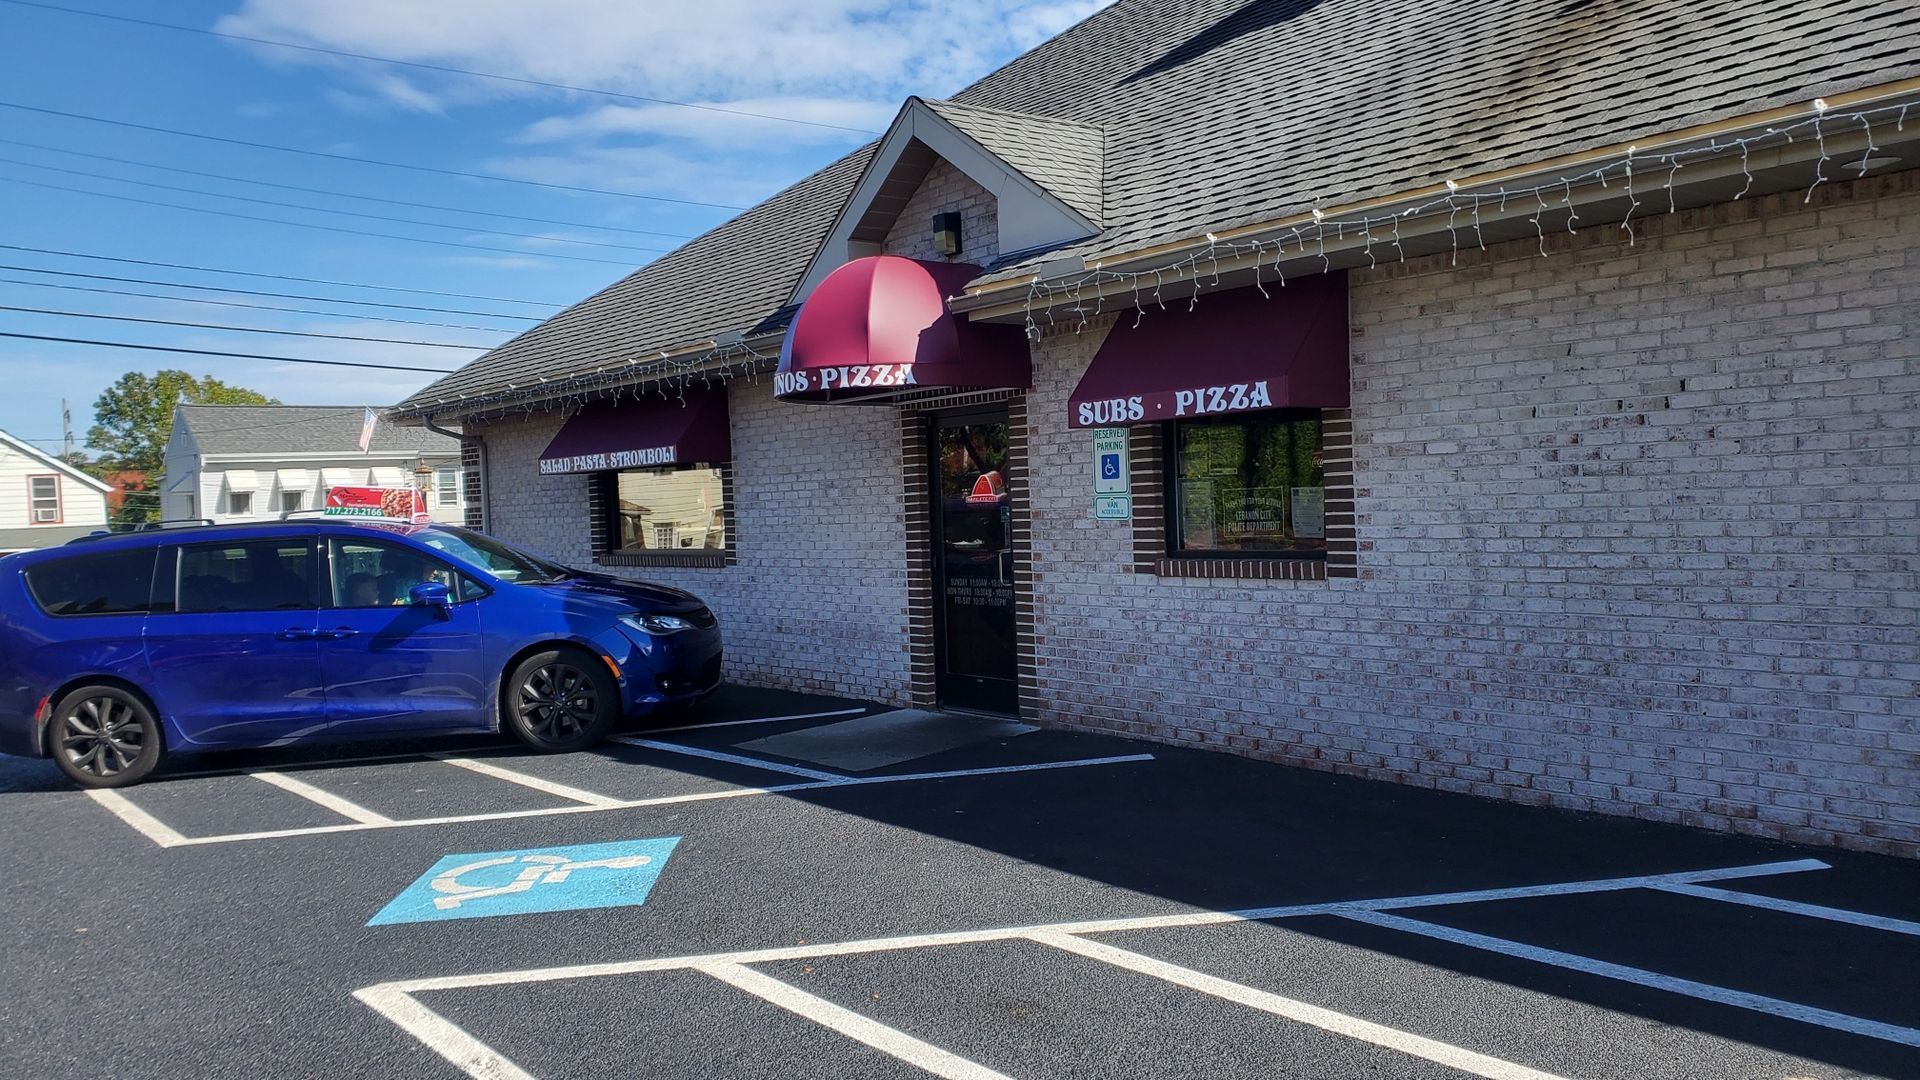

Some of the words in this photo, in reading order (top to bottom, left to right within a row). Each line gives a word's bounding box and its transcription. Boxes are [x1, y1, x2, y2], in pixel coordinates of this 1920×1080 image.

[820, 364, 917, 390] PIZZA
[1078, 397, 1145, 426] SUBS
[1175, 380, 1272, 416] PIZZA
[1095, 428, 1125, 439] RESERVED
[1096, 440, 1123, 451] PARKING
[540, 458, 571, 474] SALAD
[573, 454, 607, 471] PASTA
[610, 446, 675, 468] STROMBOLI
[1107, 501, 1118, 509] VAN
[326, 506, 382, 516] 717.273.2166
[1235, 510, 1259, 520] LEBANON
[1260, 510, 1271, 520] CITY
[1228, 522, 1246, 532] POLICE
[1246, 521, 1281, 531] DEPARTMENT
